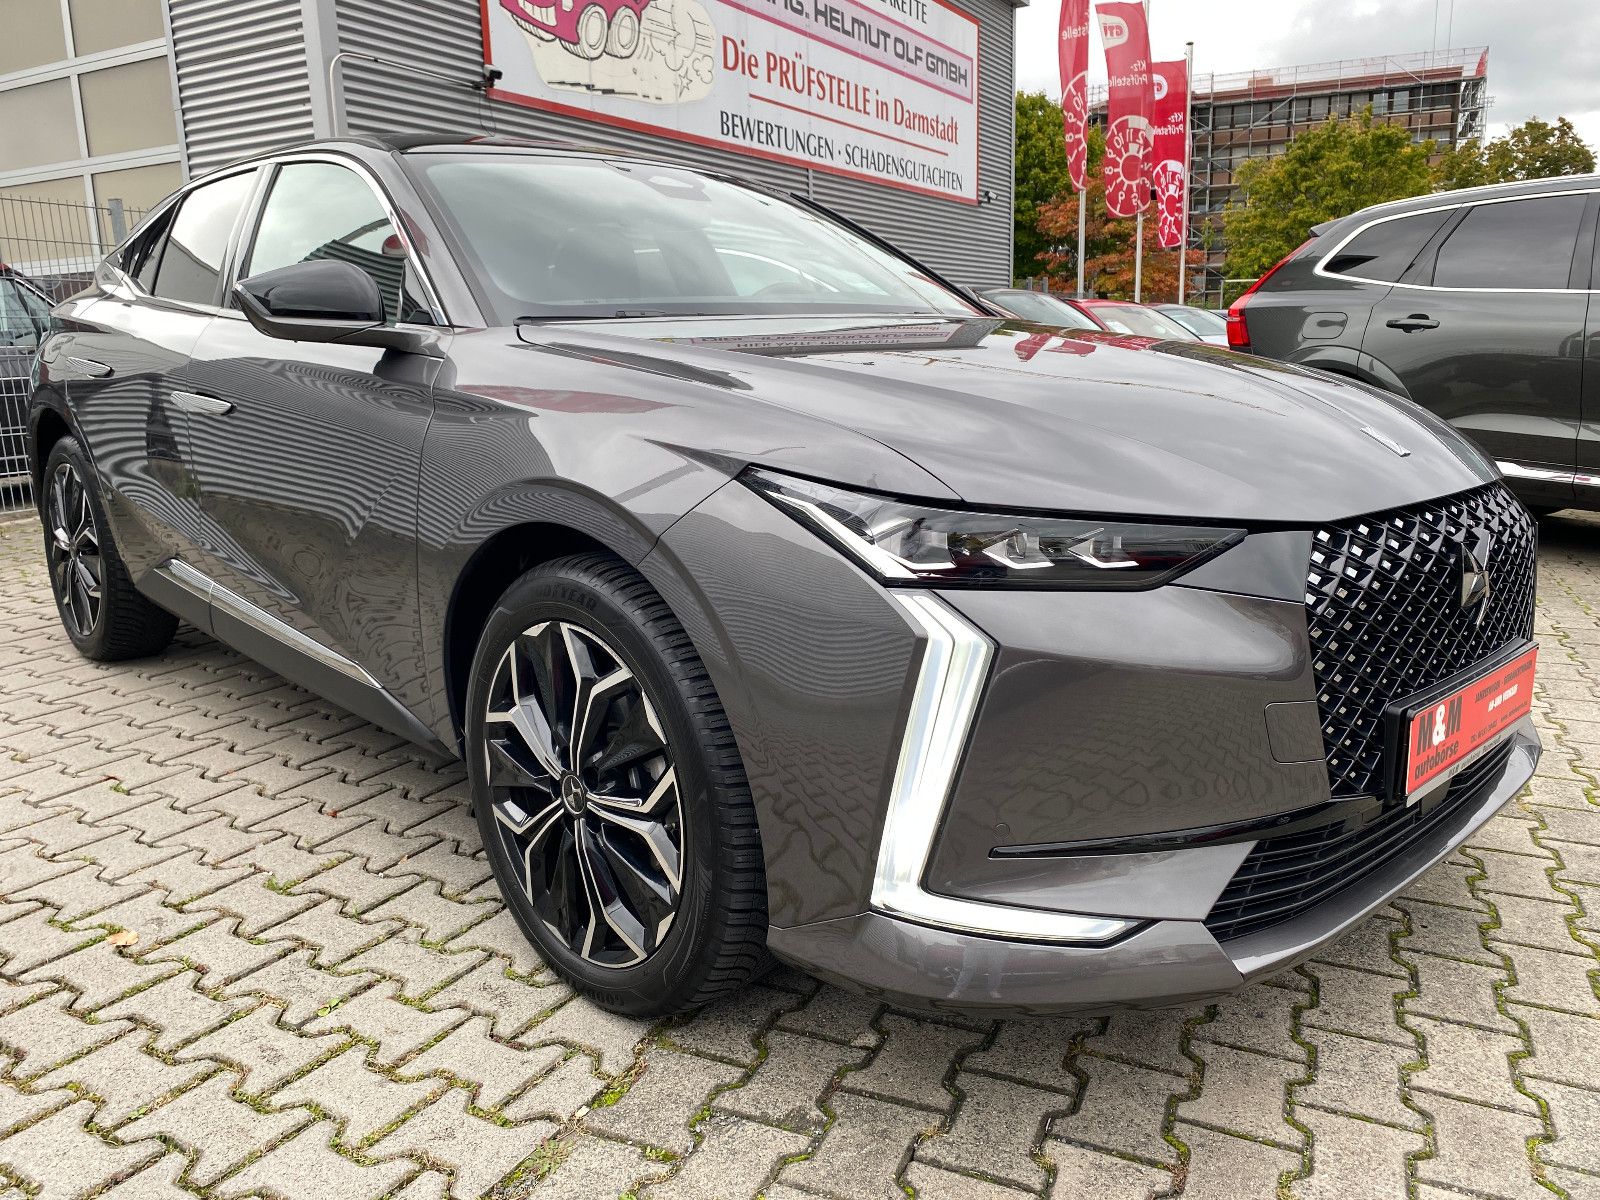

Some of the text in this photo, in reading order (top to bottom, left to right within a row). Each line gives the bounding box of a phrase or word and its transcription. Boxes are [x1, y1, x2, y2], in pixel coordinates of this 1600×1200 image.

[814, 0, 891, 53] HELMUT
[893, 36, 924, 66] OLF
[925, 52, 969, 87] GMBH
[721, 34, 960, 145] Die PRÜFSTELLE in Darmstadt
[720, 110, 964, 192] BEWERTUNGEN SCHADENSGUTACHTEN
[1414, 739, 1460, 782] autobörse
[1416, 694, 1463, 757] M&M
